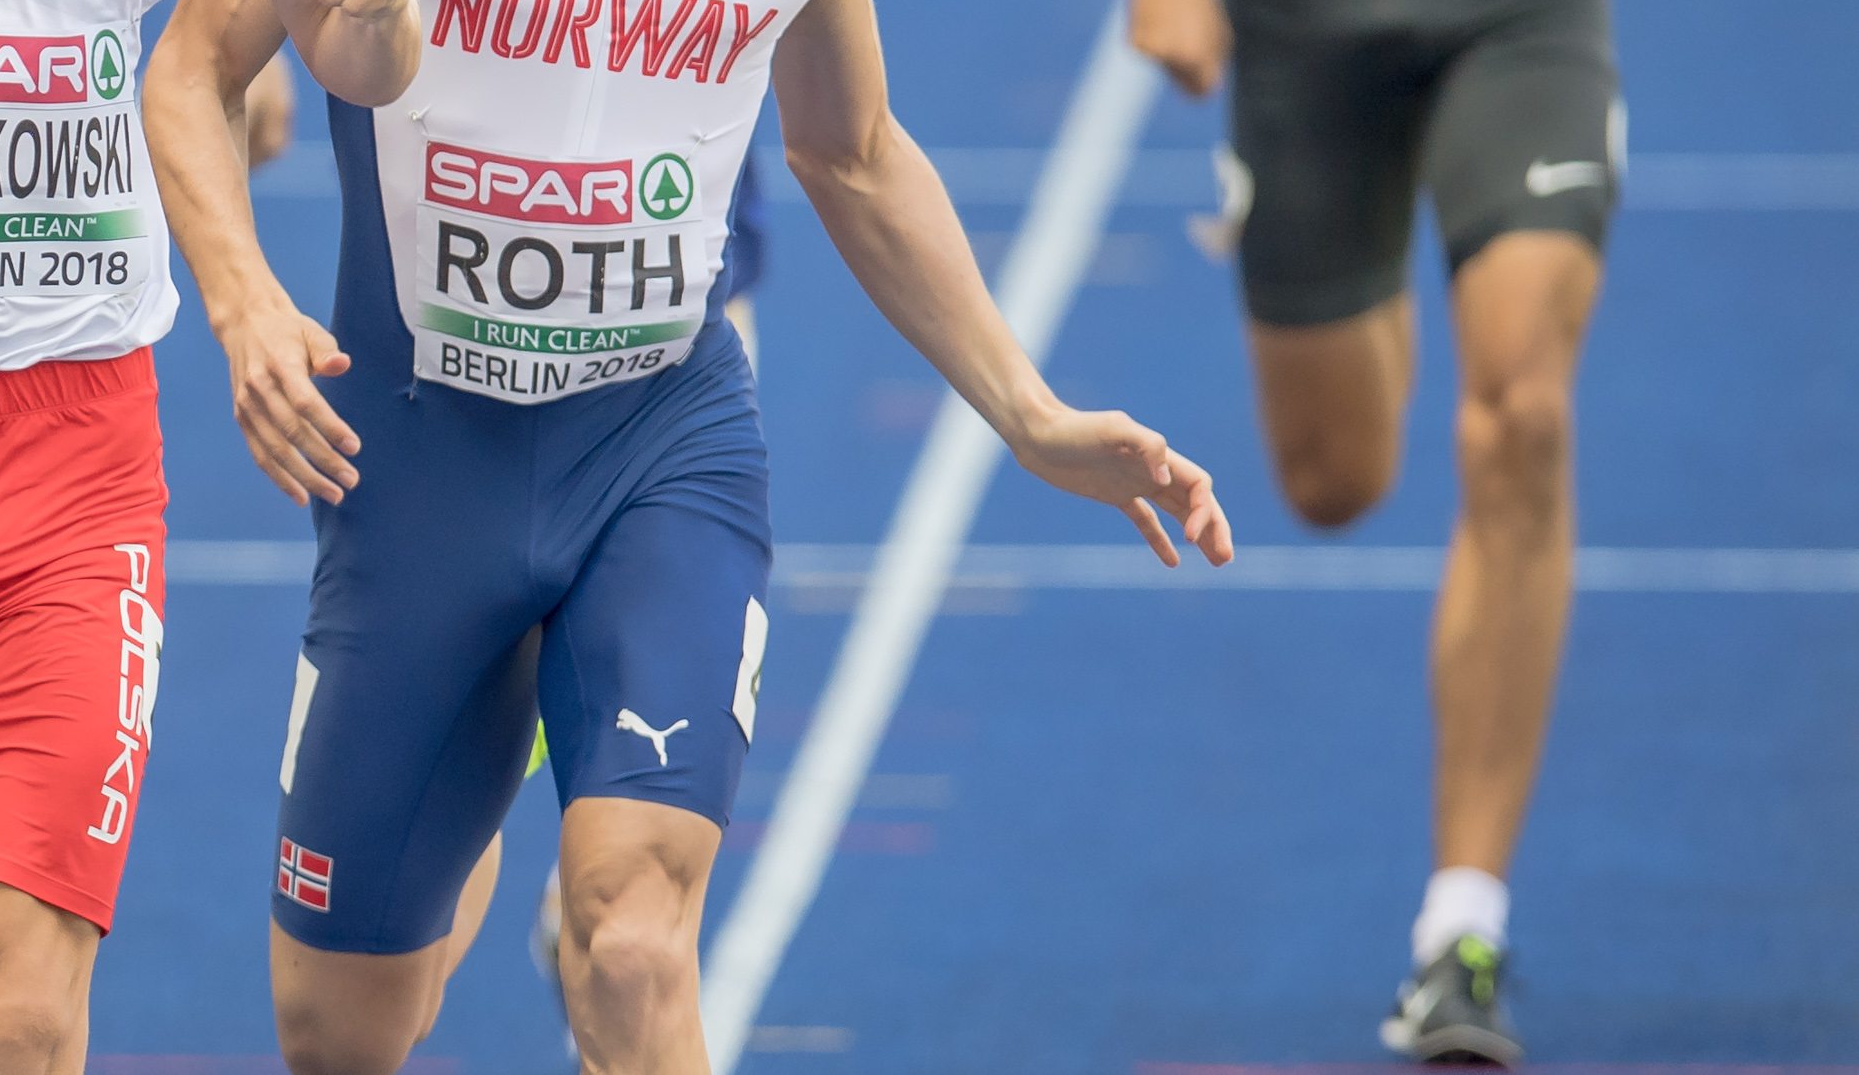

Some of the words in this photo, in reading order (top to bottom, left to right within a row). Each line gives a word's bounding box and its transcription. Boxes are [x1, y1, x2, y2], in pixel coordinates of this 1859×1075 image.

[430, 151, 630, 217] SPAR
[39, 251, 129, 288] 2018
[436, 220, 686, 314] ROTH
[474, 321, 479, 339] I
[488, 323, 539, 348] RUN
[441, 343, 571, 395] BERLIN
[578, 347, 666, 386] 2018
[87, 543, 150, 844] POLSKA
